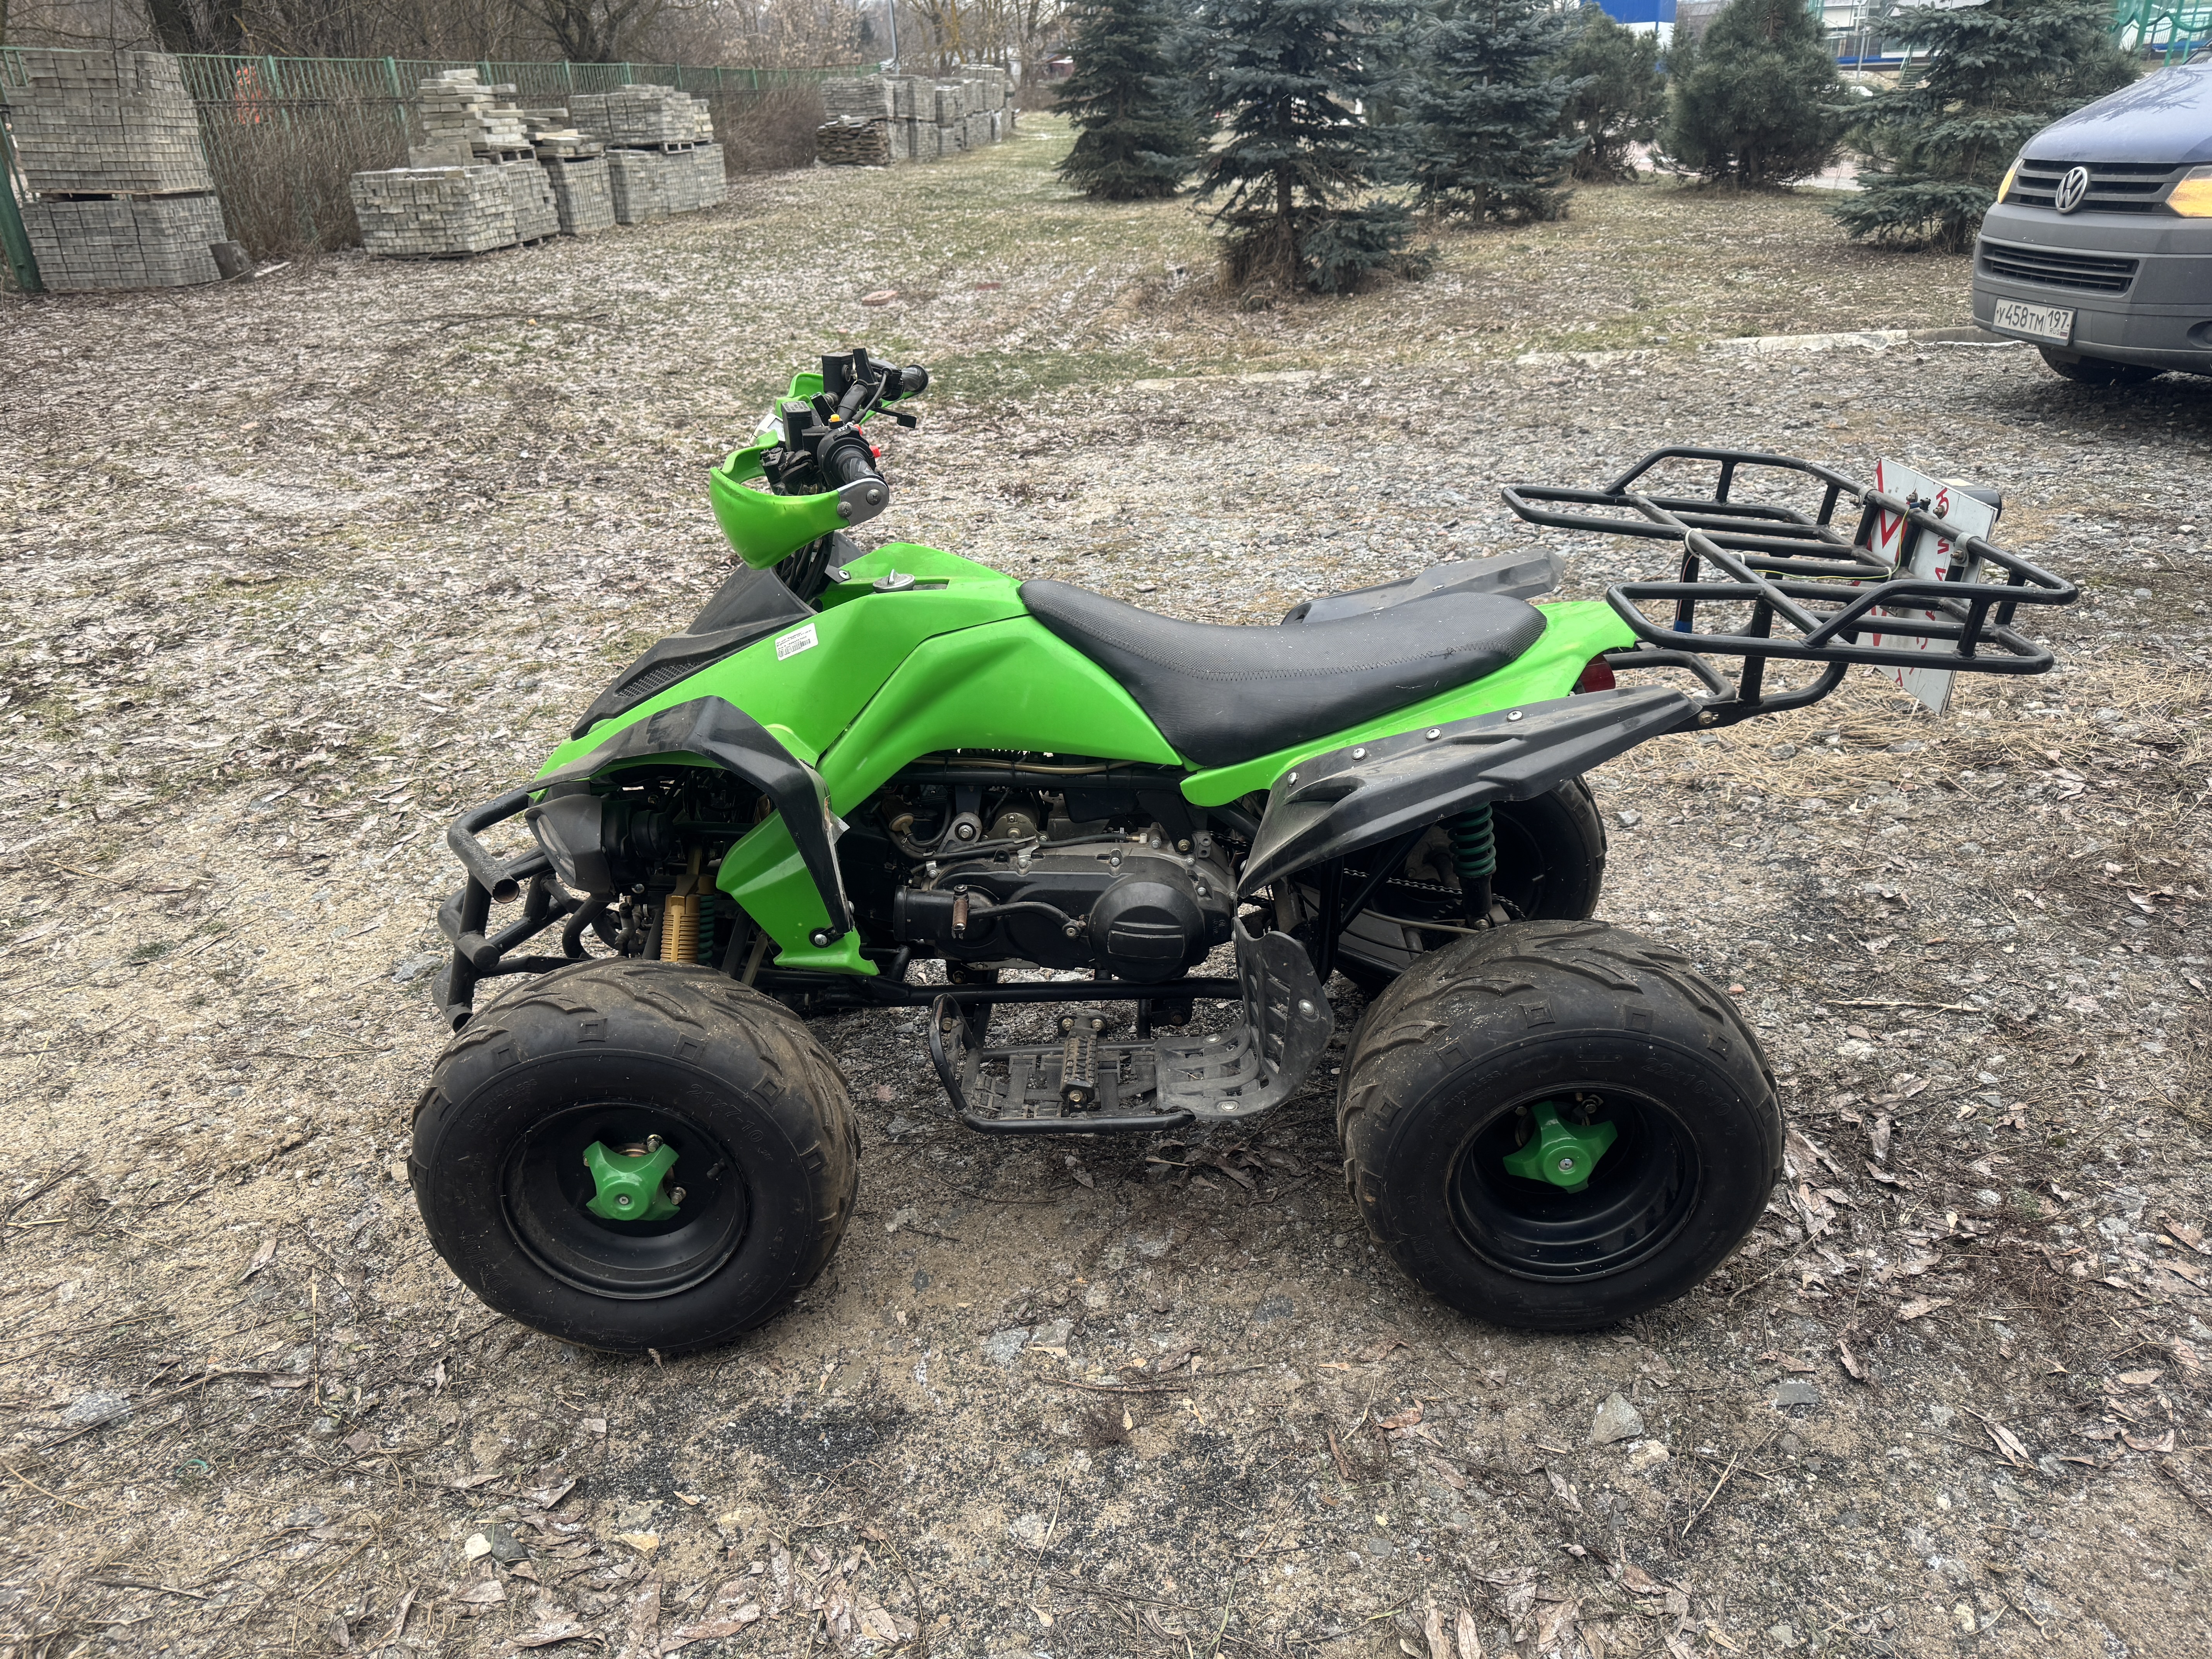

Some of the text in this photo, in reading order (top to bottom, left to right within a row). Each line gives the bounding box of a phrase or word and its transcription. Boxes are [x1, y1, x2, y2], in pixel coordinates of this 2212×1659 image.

[2048, 310, 2069, 329] 197
[483, 1079, 538, 1109] TUBELESS
[1445, 1070, 1501, 1108] TUBELESS
[687, 1084, 764, 1143] 21x7-10
